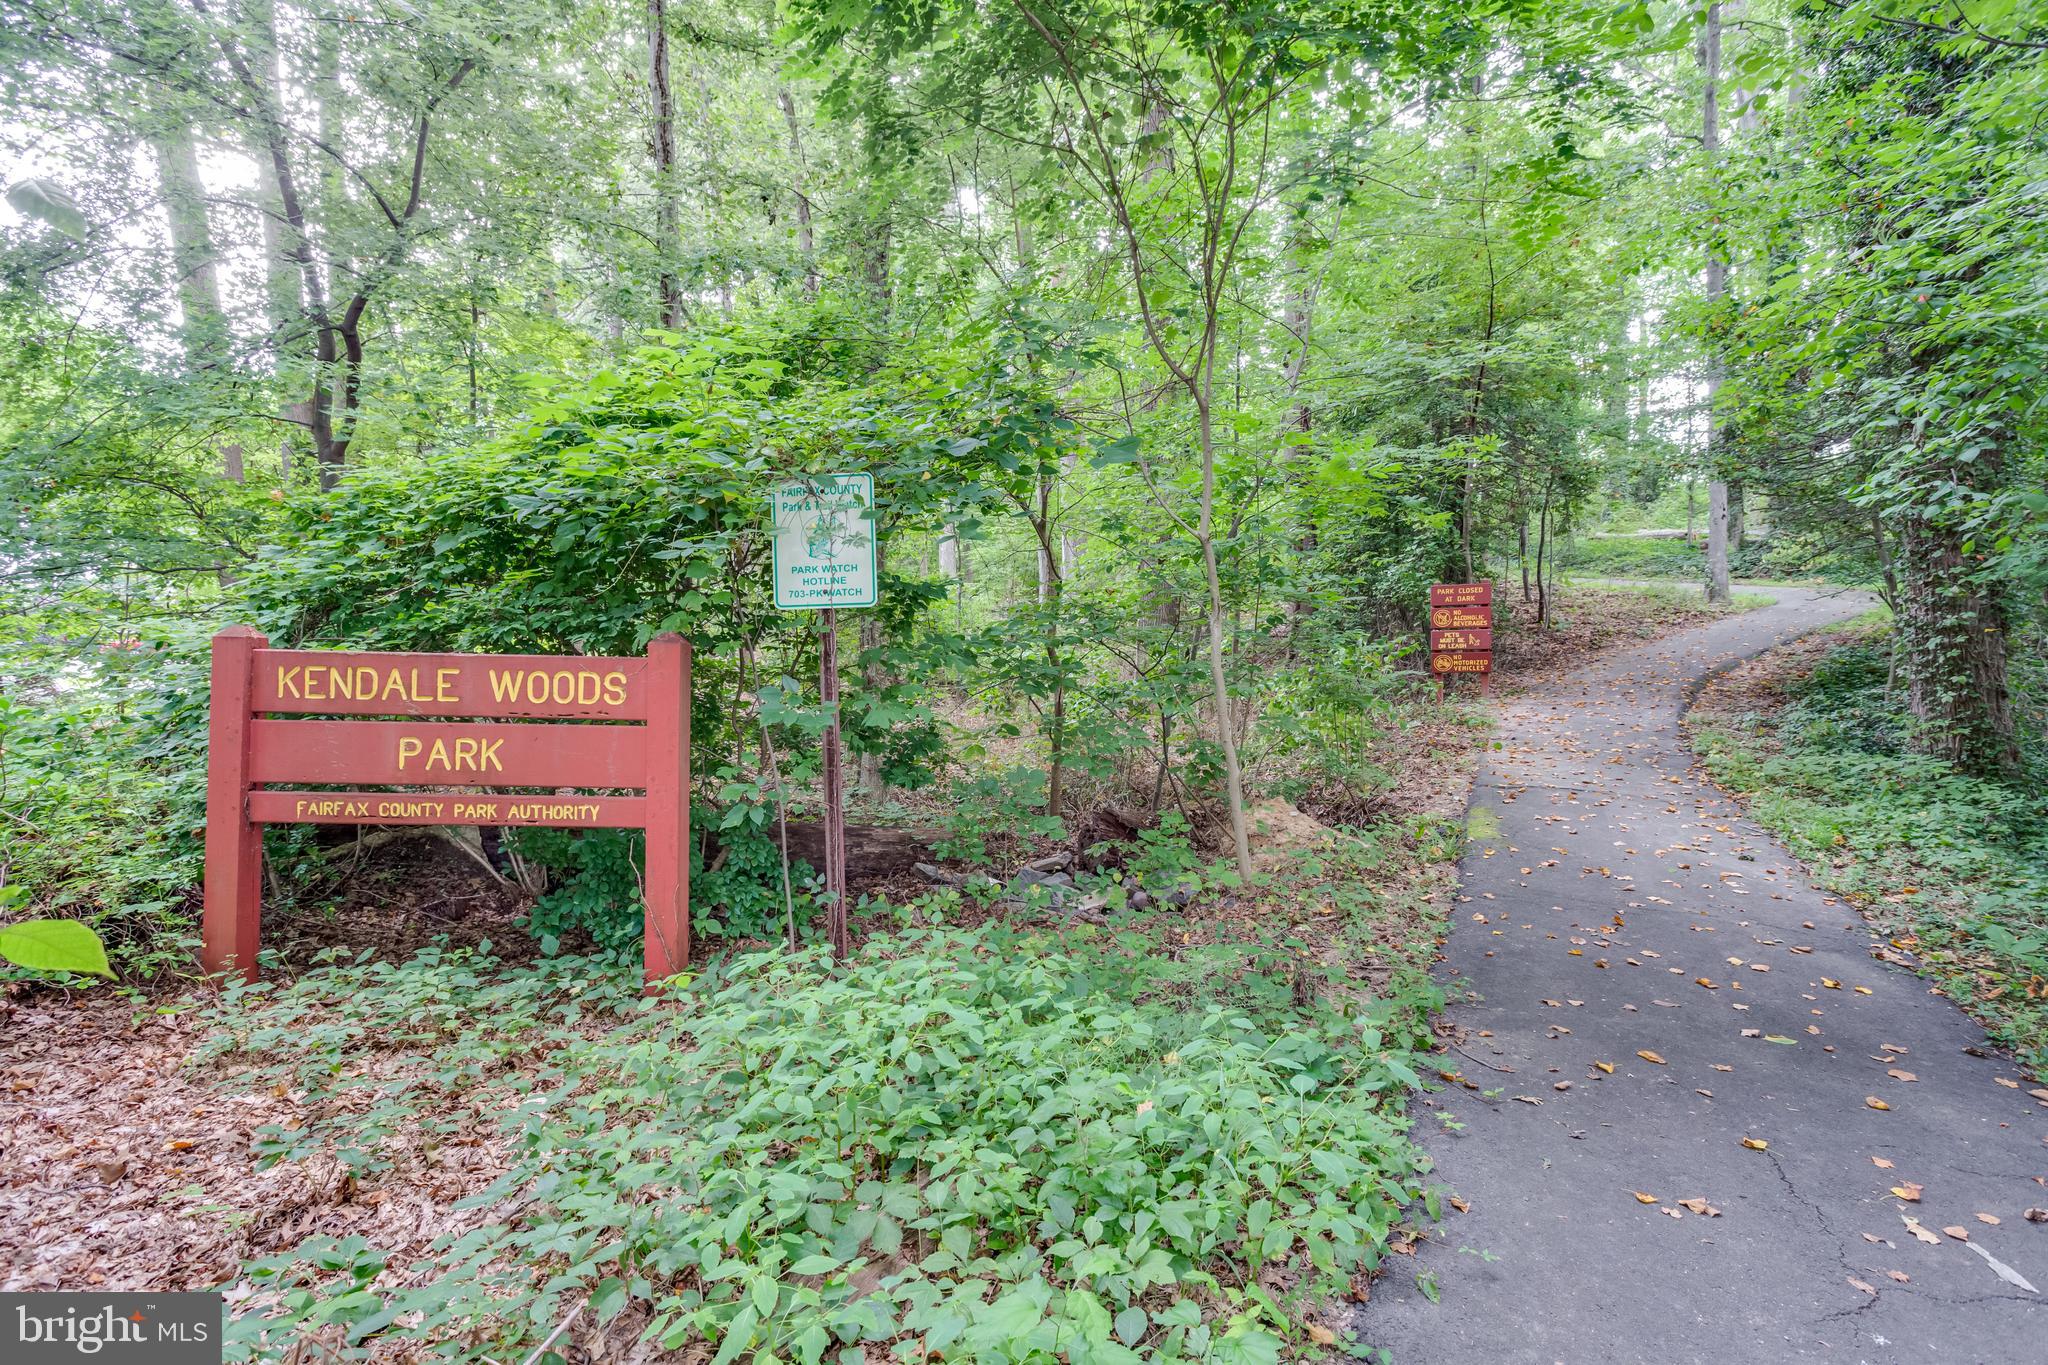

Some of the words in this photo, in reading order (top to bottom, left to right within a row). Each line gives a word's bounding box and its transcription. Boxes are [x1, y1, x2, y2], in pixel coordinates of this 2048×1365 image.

[781, 486, 820, 497] FAIRFX
[824, 484, 862, 495] COUNTY
[782, 501, 802, 512] Park
[805, 501, 811, 511] &
[791, 565, 818, 574] PARK
[821, 564, 858, 573] WATCH
[802, 576, 847, 586] HOTLINE
[277, 665, 461, 703] KENDALE
[488, 669, 628, 706] WOODS
[398, 736, 505, 772] PARK
[296, 800, 369, 817] FAIRFAX
[379, 801, 444, 818] COUNTY
[454, 803, 497, 820] PARK
[507, 804, 601, 822] AUTHORITY
